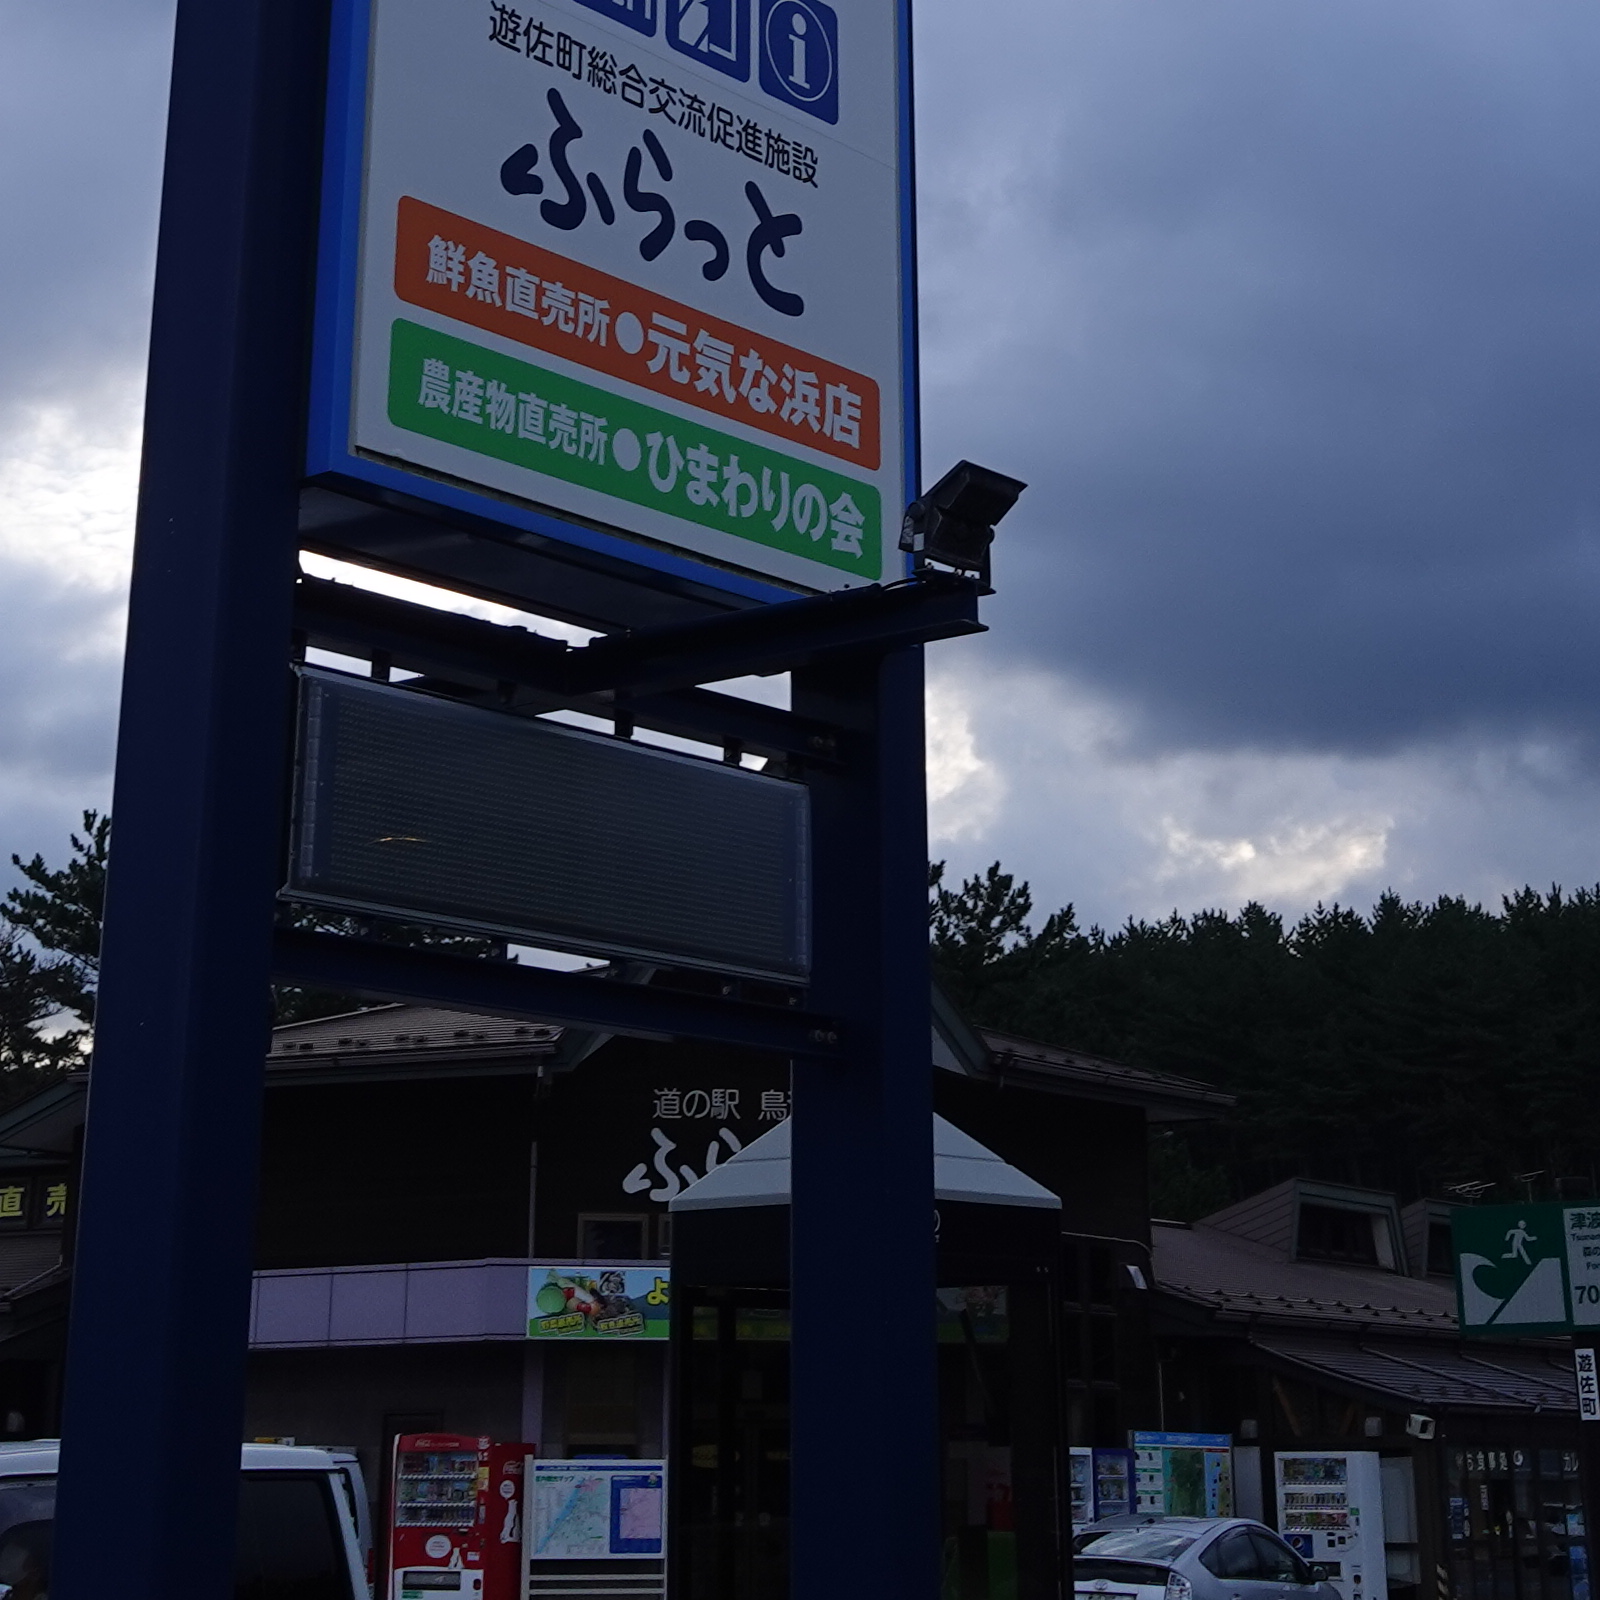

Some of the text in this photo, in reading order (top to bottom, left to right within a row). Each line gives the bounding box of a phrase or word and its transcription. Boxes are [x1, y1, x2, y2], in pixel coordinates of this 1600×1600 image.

[488, 0, 819, 188] 遊佐町総合交流促進施設
[500, 87, 805, 317] ふらっと
[652, 1088, 791, 1121] 道の駅 鳥
[1577, 1353, 1596, 1416] 遊佐町
